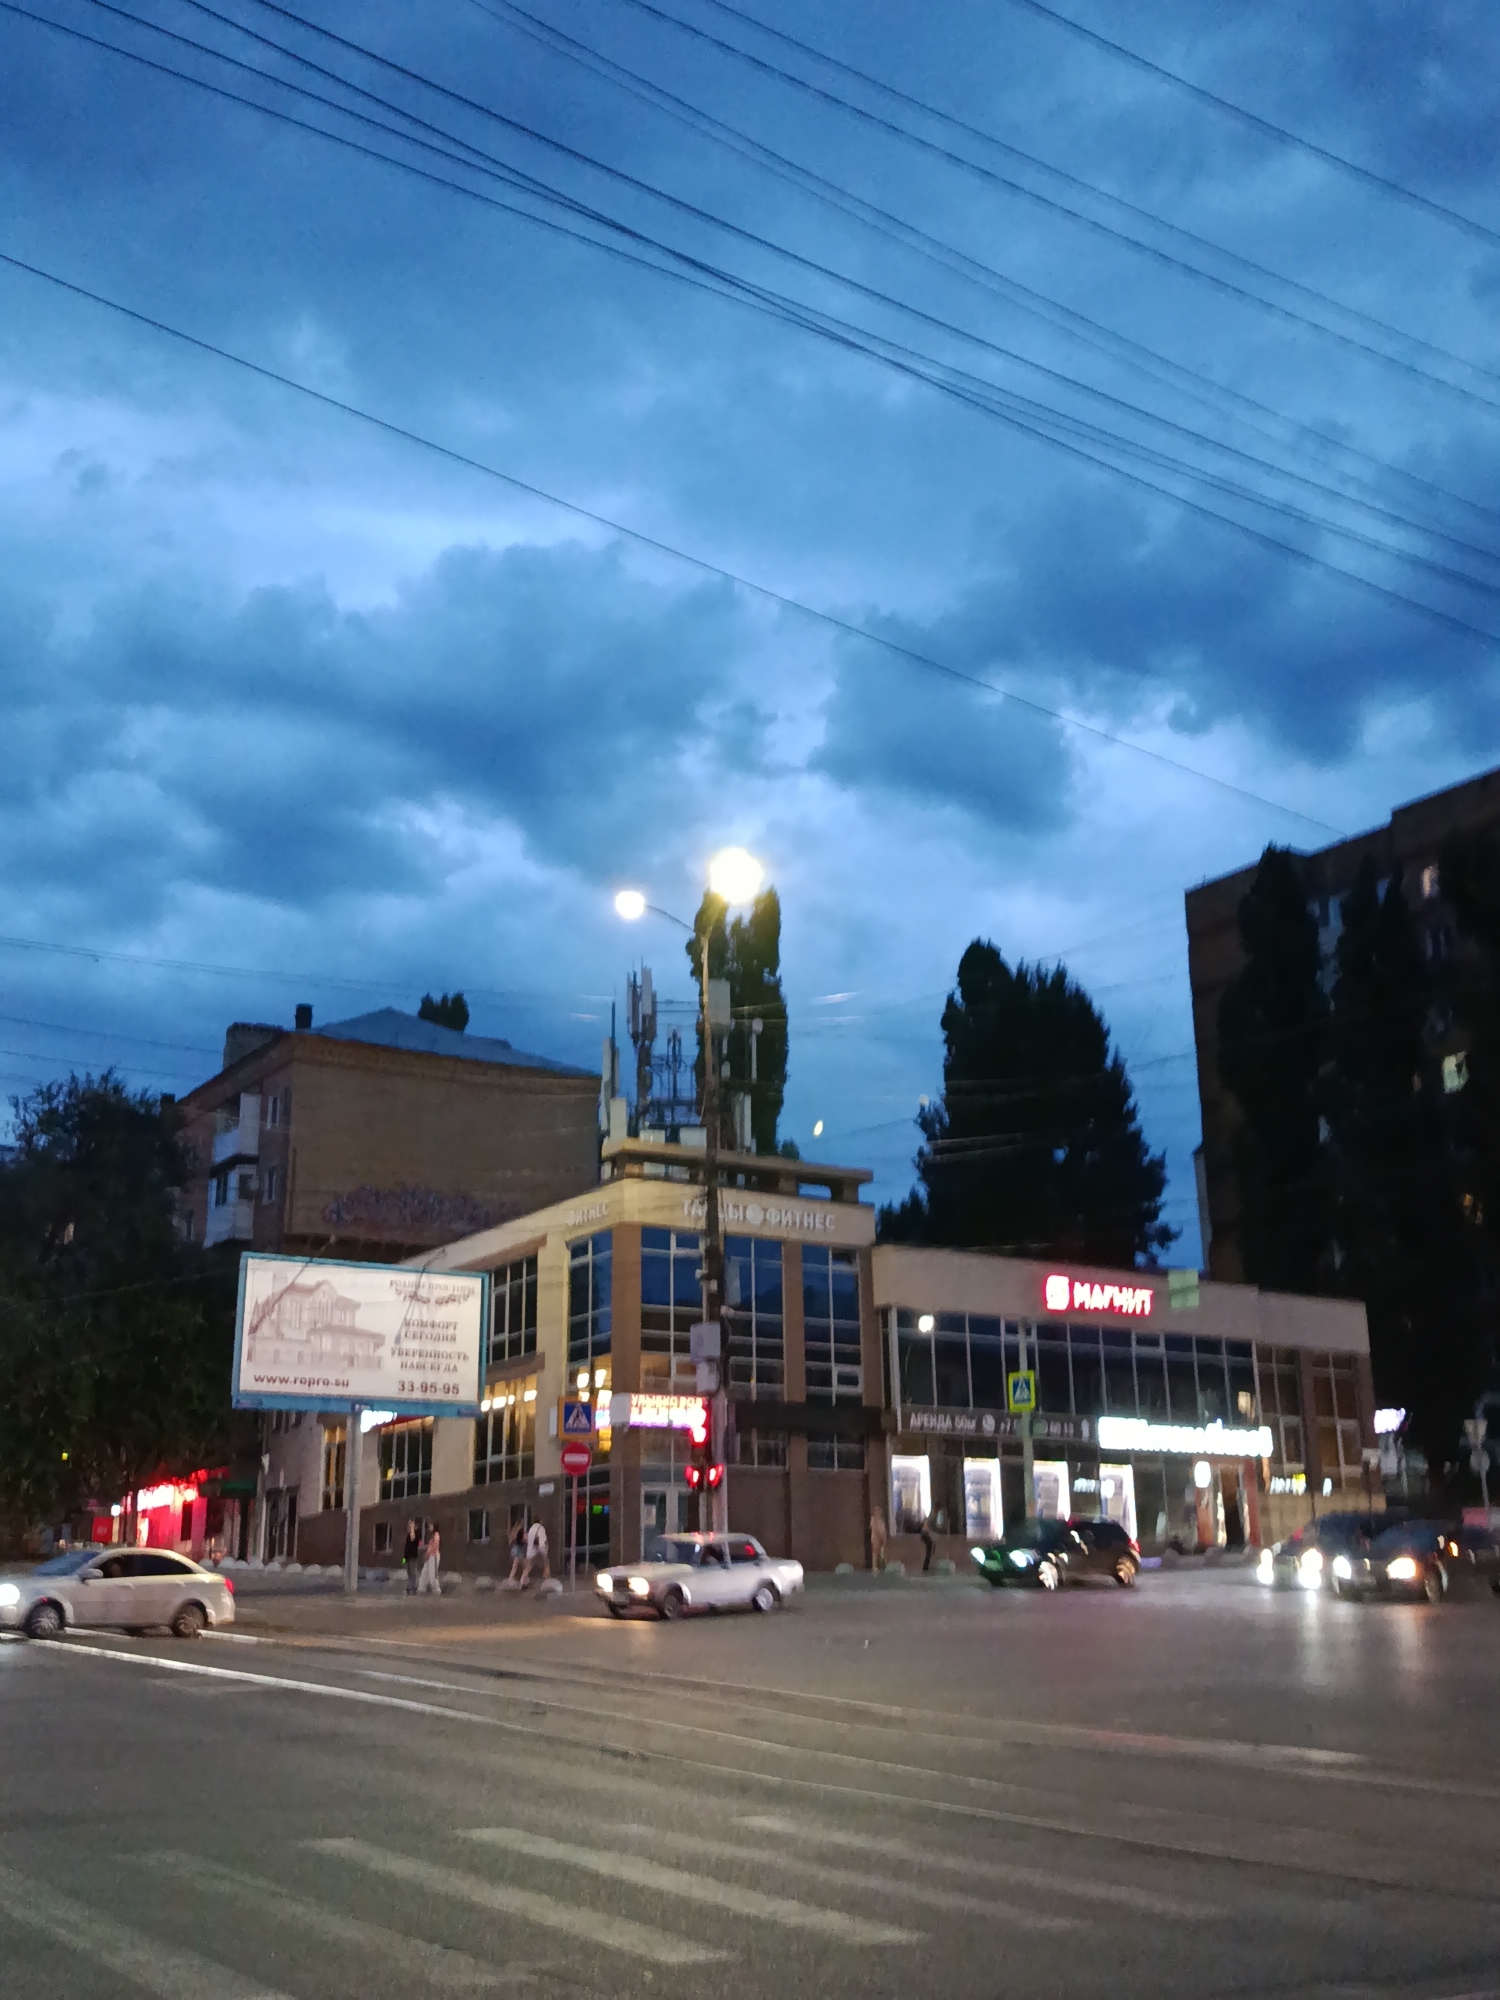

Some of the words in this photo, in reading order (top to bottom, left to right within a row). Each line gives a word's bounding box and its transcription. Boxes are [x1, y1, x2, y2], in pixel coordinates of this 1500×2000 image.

[766, 1205, 836, 1231] ФИТНЕС
[1072, 1280, 1154, 1316] МАГНИТ
[404, 1318, 458, 1330] КОМФОРТ
[404, 1330, 457, 1343] СЕГОДНЯ
[391, 1346, 469, 1361] УВЕРЕННОСТЬ
[400, 1360, 458, 1373] НАВСЕГДА
[253, 1374, 350, 1390] www.ropro.su
[398, 1380, 460, 1395] 33-95-95
[909, 1411, 953, 1433] АРЕНДА
